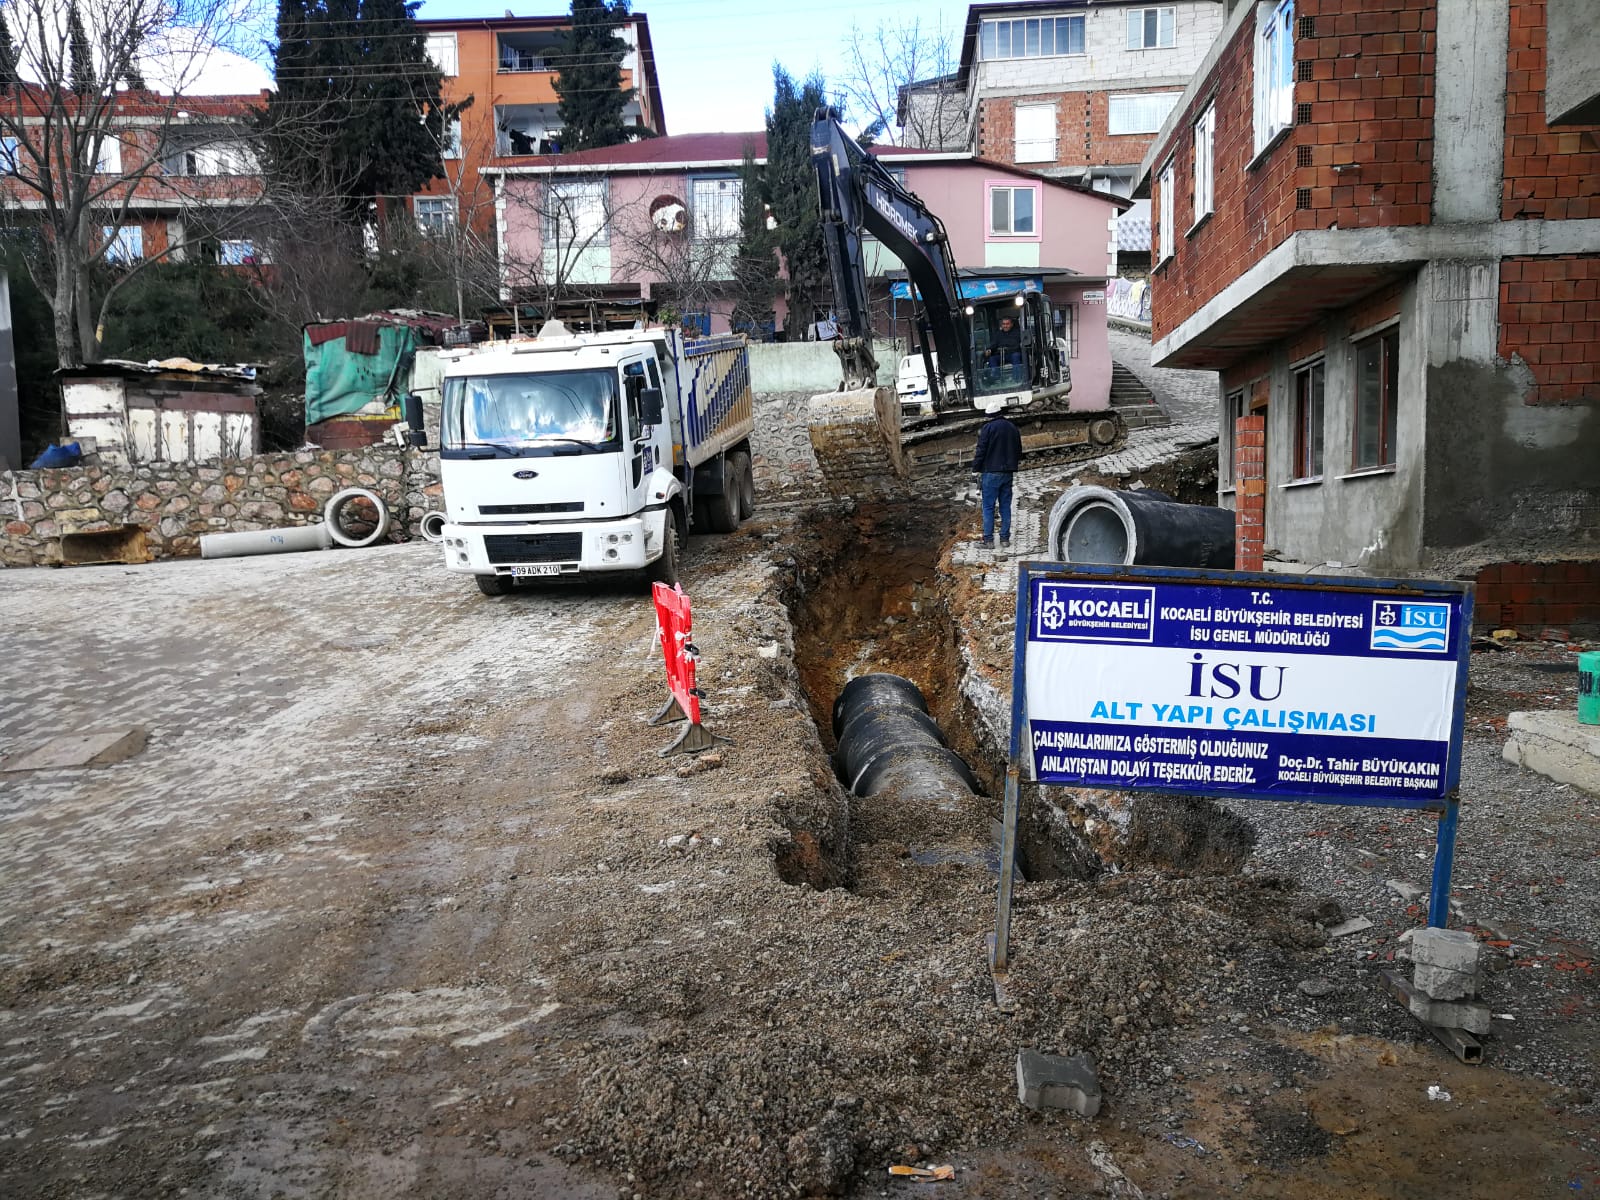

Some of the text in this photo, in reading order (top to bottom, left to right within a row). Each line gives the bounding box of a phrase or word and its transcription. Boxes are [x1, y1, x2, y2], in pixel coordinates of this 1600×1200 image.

[516, 566, 526, 575] 09
[543, 566, 558, 574] 210
[1251, 591, 1274, 605] T.C.
[1068, 599, 1150, 619] KOCAELİ
[1160, 606, 1364, 629] KOCAELİ BÜYÜKŞEHİR BELEDİYESİ
[1403, 607, 1447, 627] İSU
[1190, 625, 1331, 647] İSU GENEL MÜDÜRLÜĞÜ
[1184, 652, 1290, 702] İSU
[1090, 700, 1376, 734] ALT YAPI ÇALIŞMASI
[1033, 730, 1269, 760] ÇALIŞMALARIMIZA GÖSTERMİŞ OLDUĞUNUZ
[1041, 755, 1257, 784] ANLAYIŞTAN DOLAYI TEŞEKKÜR EDERİZ.
[1279, 755, 1440, 776] Doç.Dr. Tahir BÜYÜKAKIN
[1404, 777, 1438, 790] BAŞKANI
